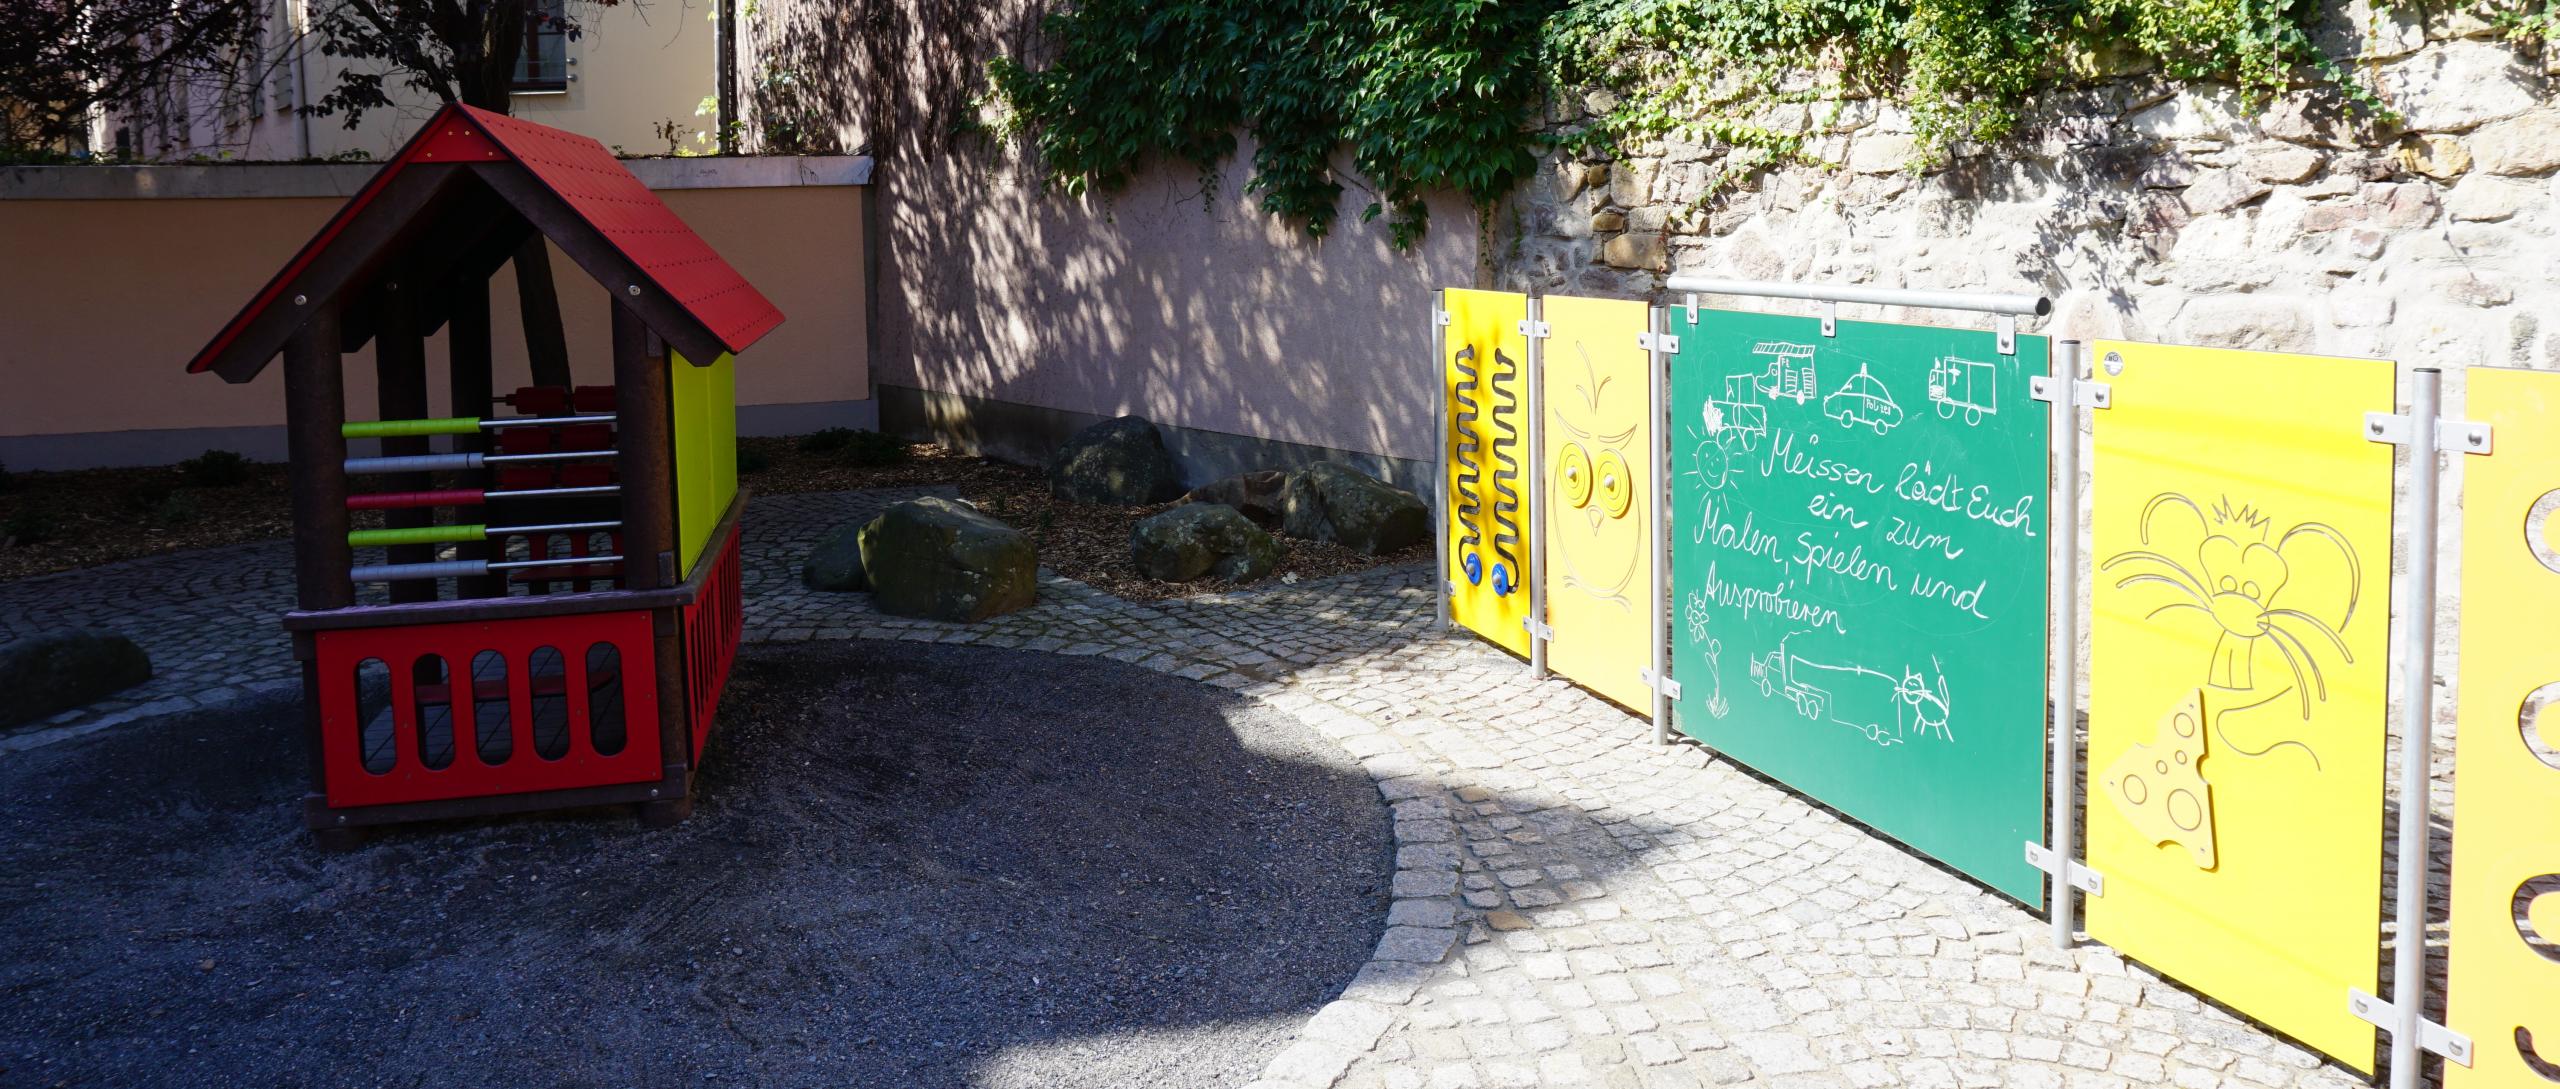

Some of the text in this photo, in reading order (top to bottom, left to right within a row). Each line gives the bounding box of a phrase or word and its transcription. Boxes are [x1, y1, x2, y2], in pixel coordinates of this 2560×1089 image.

[1762, 427, 2036, 537] Meissen lädt Euch
[1807, 492, 1965, 560] ein zum
[1694, 498, 1990, 619] Malen, Spielen und
[1702, 560, 1847, 635] Ausprobieren
